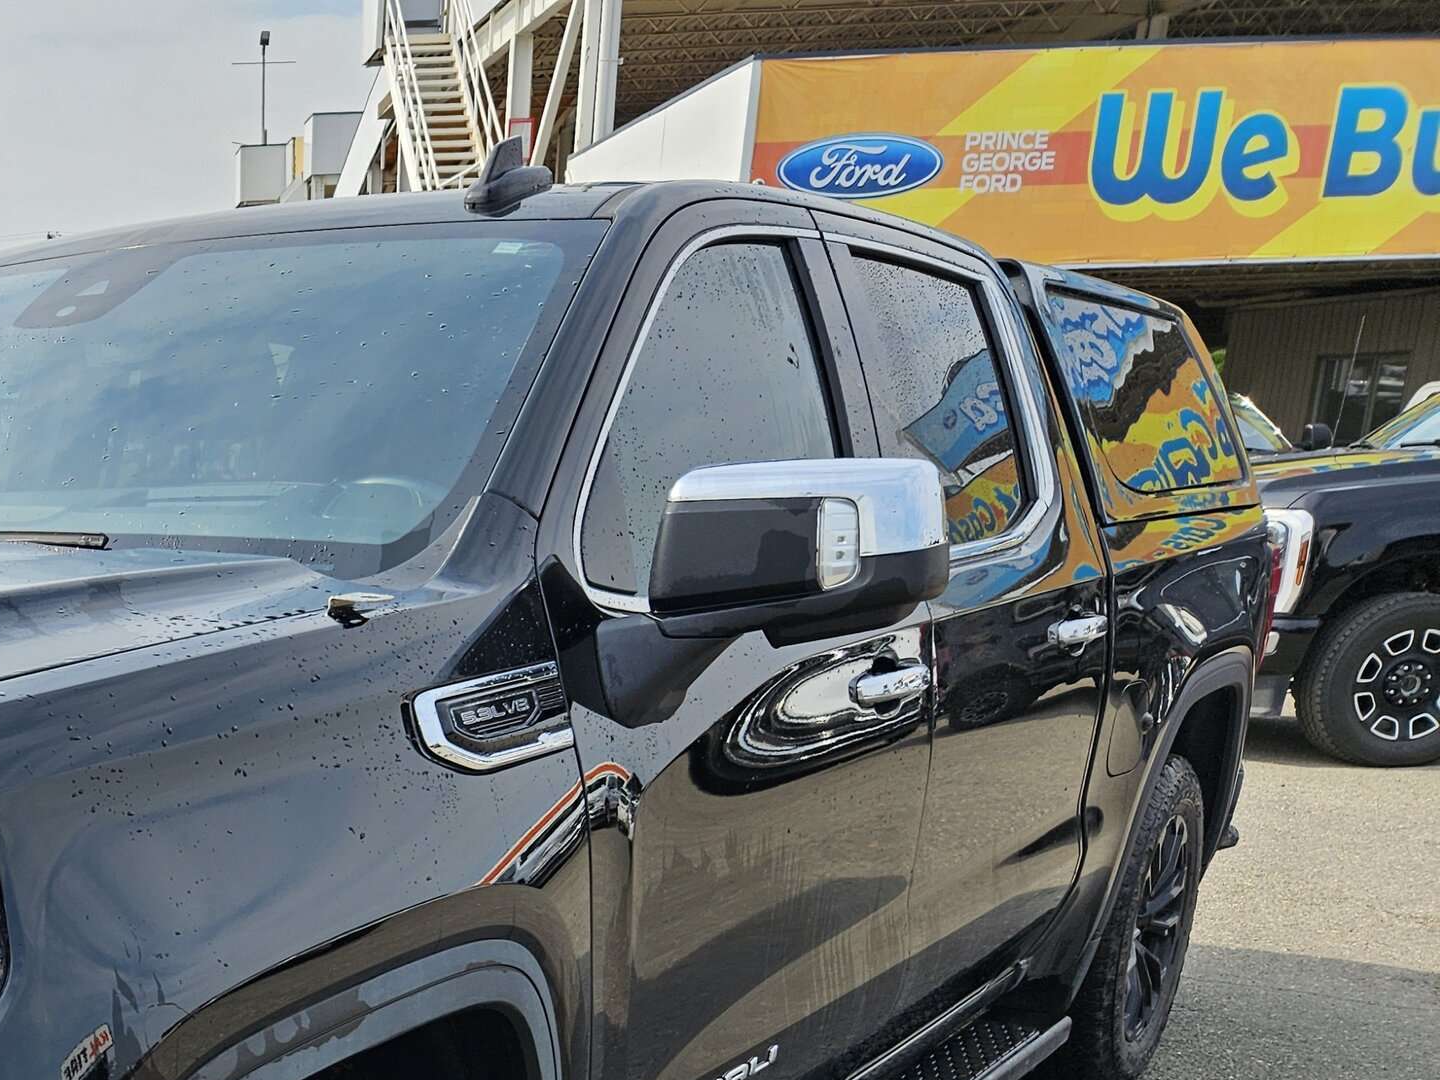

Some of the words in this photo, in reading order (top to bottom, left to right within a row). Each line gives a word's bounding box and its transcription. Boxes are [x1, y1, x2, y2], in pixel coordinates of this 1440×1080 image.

[964, 129, 1050, 151] PRINCE
[1090, 88, 1291, 207] We
[809, 144, 912, 189] Ford
[961, 151, 1057, 173] GEORGE
[959, 173, 1023, 194] FORD
